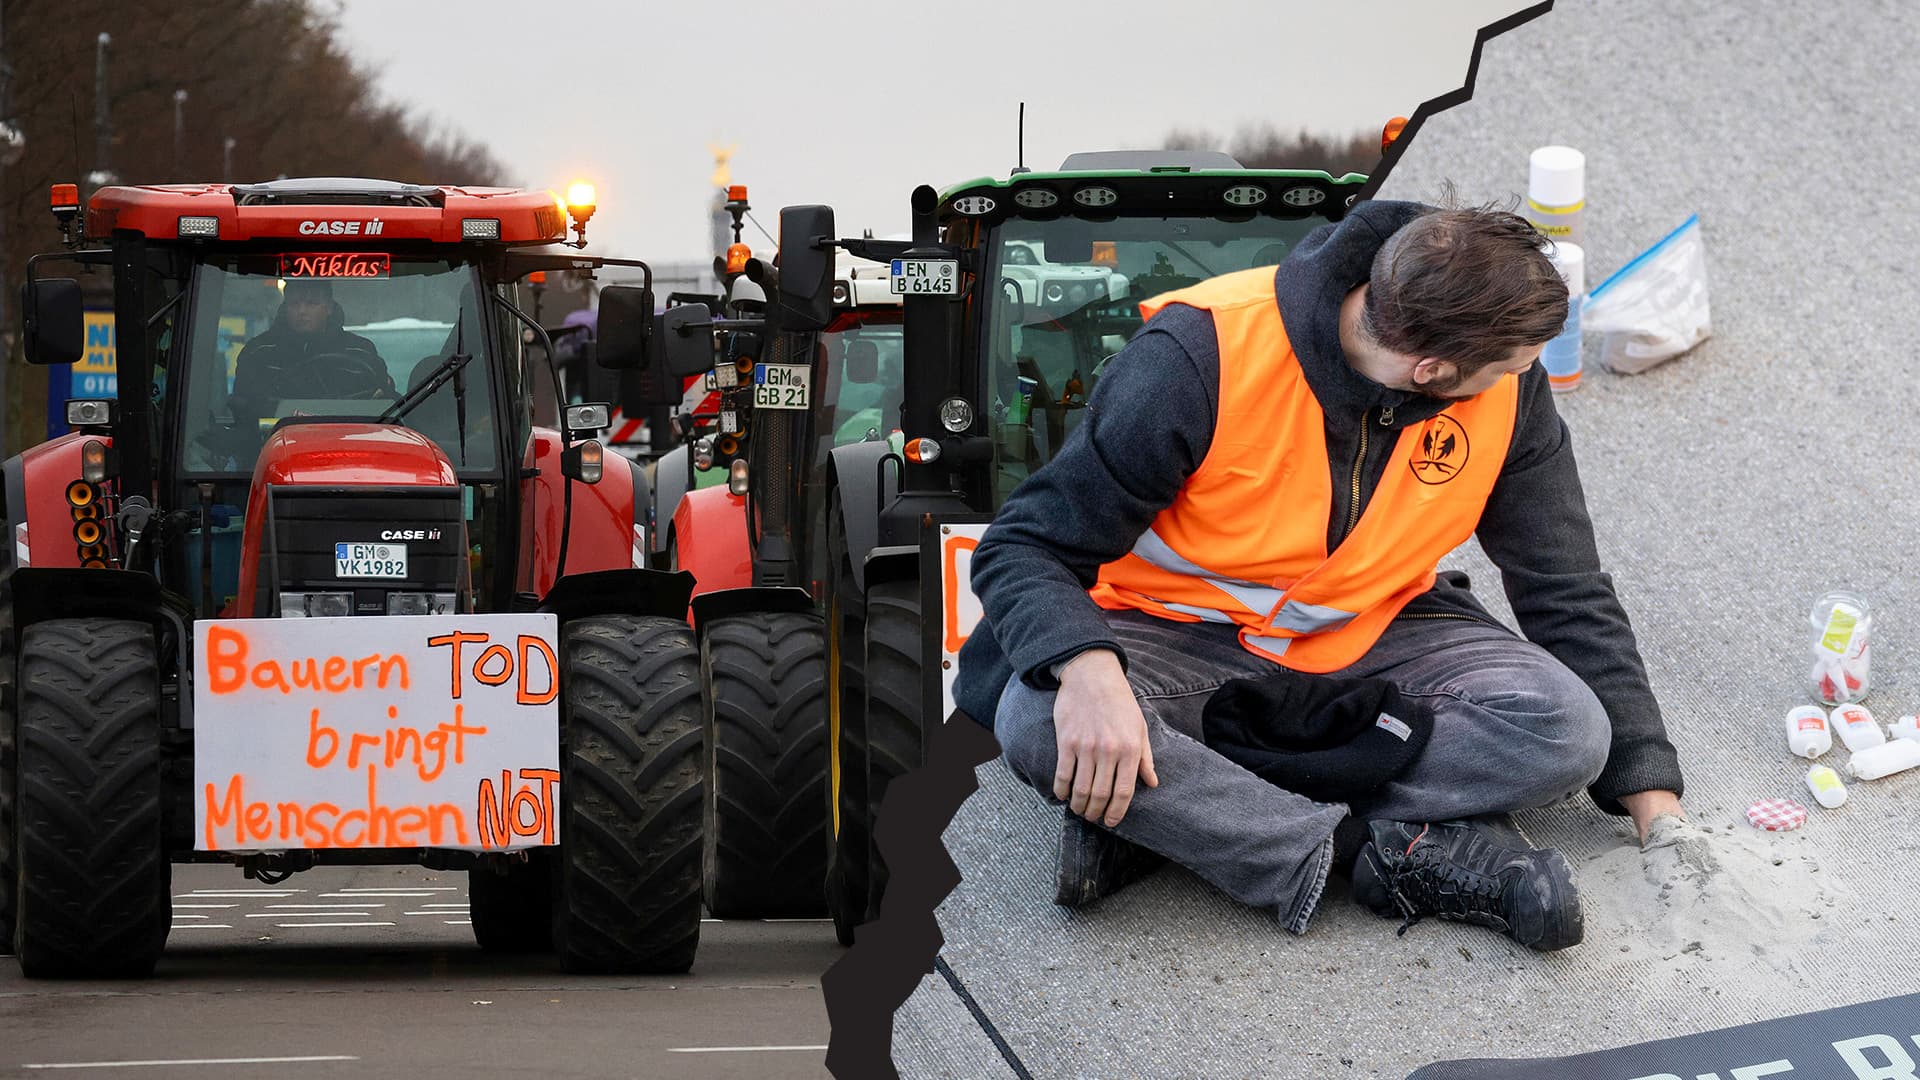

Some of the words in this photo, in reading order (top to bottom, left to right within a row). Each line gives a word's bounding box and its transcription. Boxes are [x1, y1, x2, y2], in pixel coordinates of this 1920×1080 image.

[299, 221, 360, 235] CASE
[291, 254, 380, 277] Niklas
[906, 262, 927, 277] EN
[897, 278, 907, 292] B
[912, 278, 952, 293] 6145
[88, 324, 116, 348] N
[767, 367, 792, 386] GM
[756, 387, 780, 406] GB
[784, 388, 808, 407] 21
[381, 530, 425, 540] CASE
[353, 545, 376, 560] GM
[206, 625, 410, 694] Bauern
[305, 703, 488, 782] bringt
[204, 763, 470, 849] Menschen
